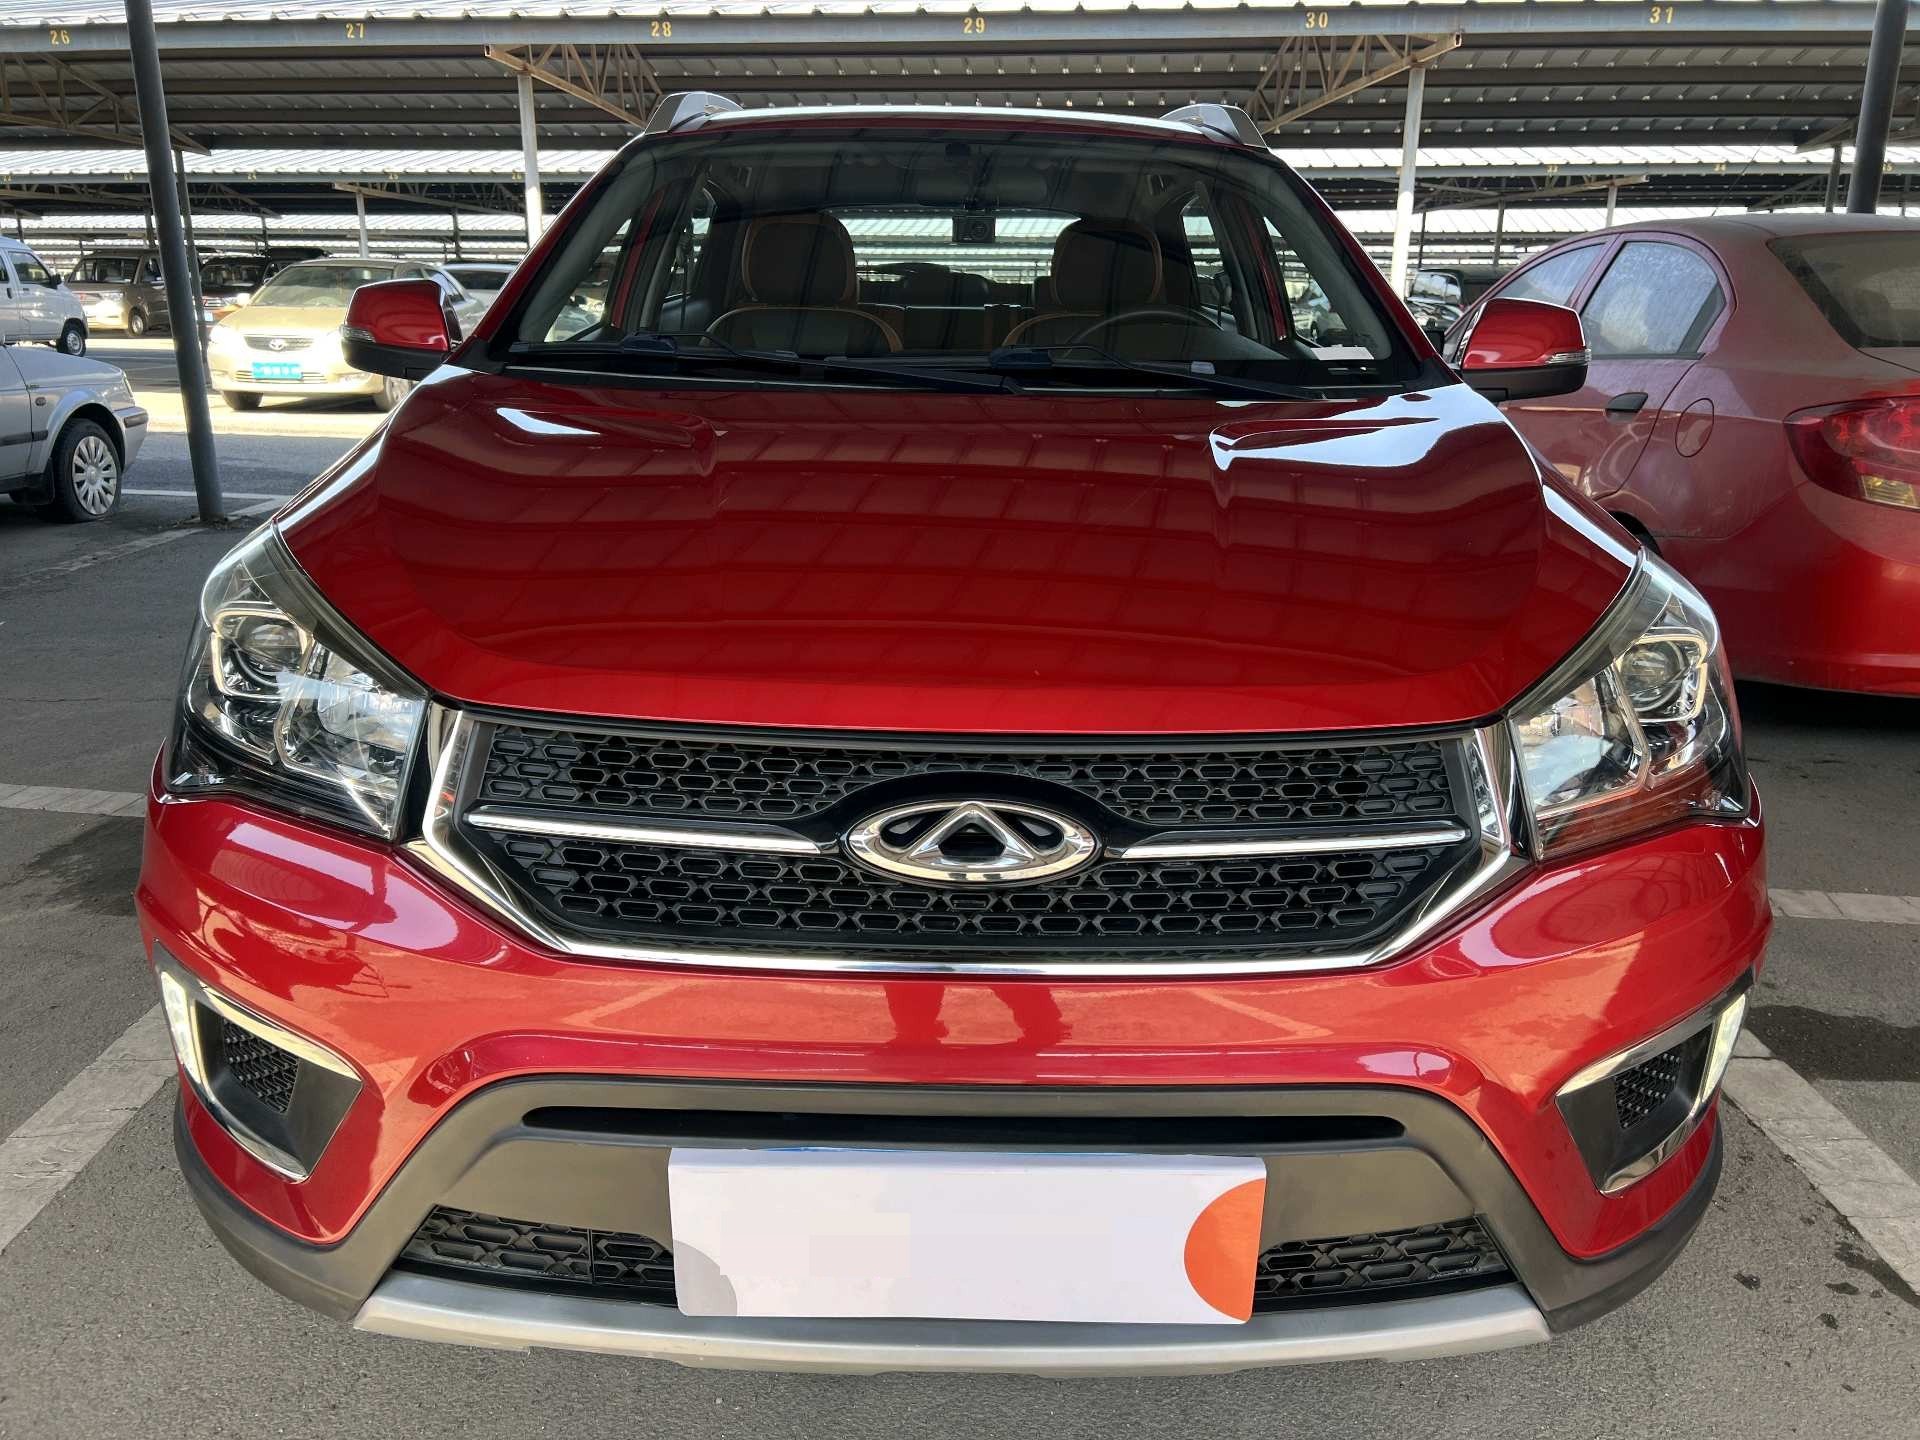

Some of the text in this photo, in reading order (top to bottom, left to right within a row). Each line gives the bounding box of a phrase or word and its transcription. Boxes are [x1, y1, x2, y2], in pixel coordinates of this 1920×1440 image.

[1305, 11, 1328, 28] 30
[1650, 6, 1674, 24] 31
[345, 23, 364, 39] 27
[650, 21, 672, 37] 28
[963, 17, 985, 34] 29
[49, 30, 71, 45] 26
